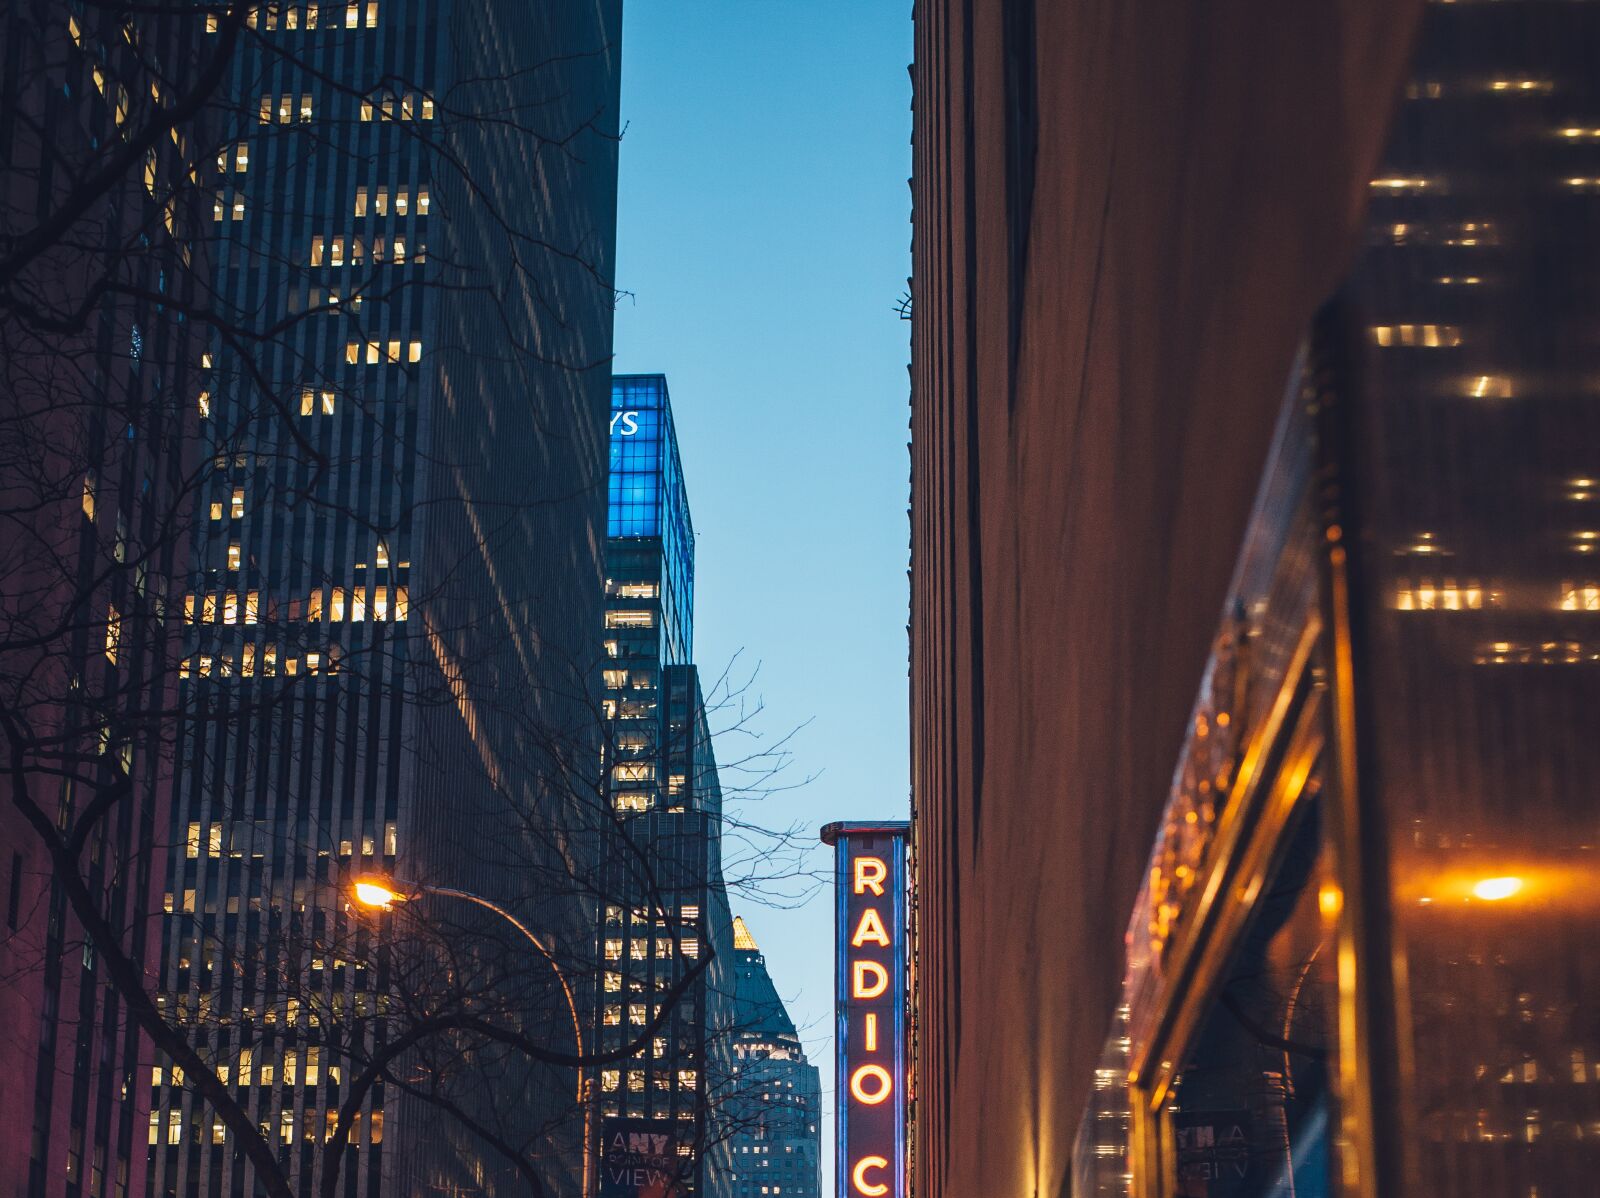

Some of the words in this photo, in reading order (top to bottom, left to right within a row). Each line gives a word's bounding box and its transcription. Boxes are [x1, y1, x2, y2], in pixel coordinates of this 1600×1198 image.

[850, 855, 893, 1105] RADIO
[609, 1132, 669, 1155] ANY
[609, 1154, 650, 1166] POINT
[651, 1156, 670, 1168] OF
[609, 1168, 668, 1187] VIEW
